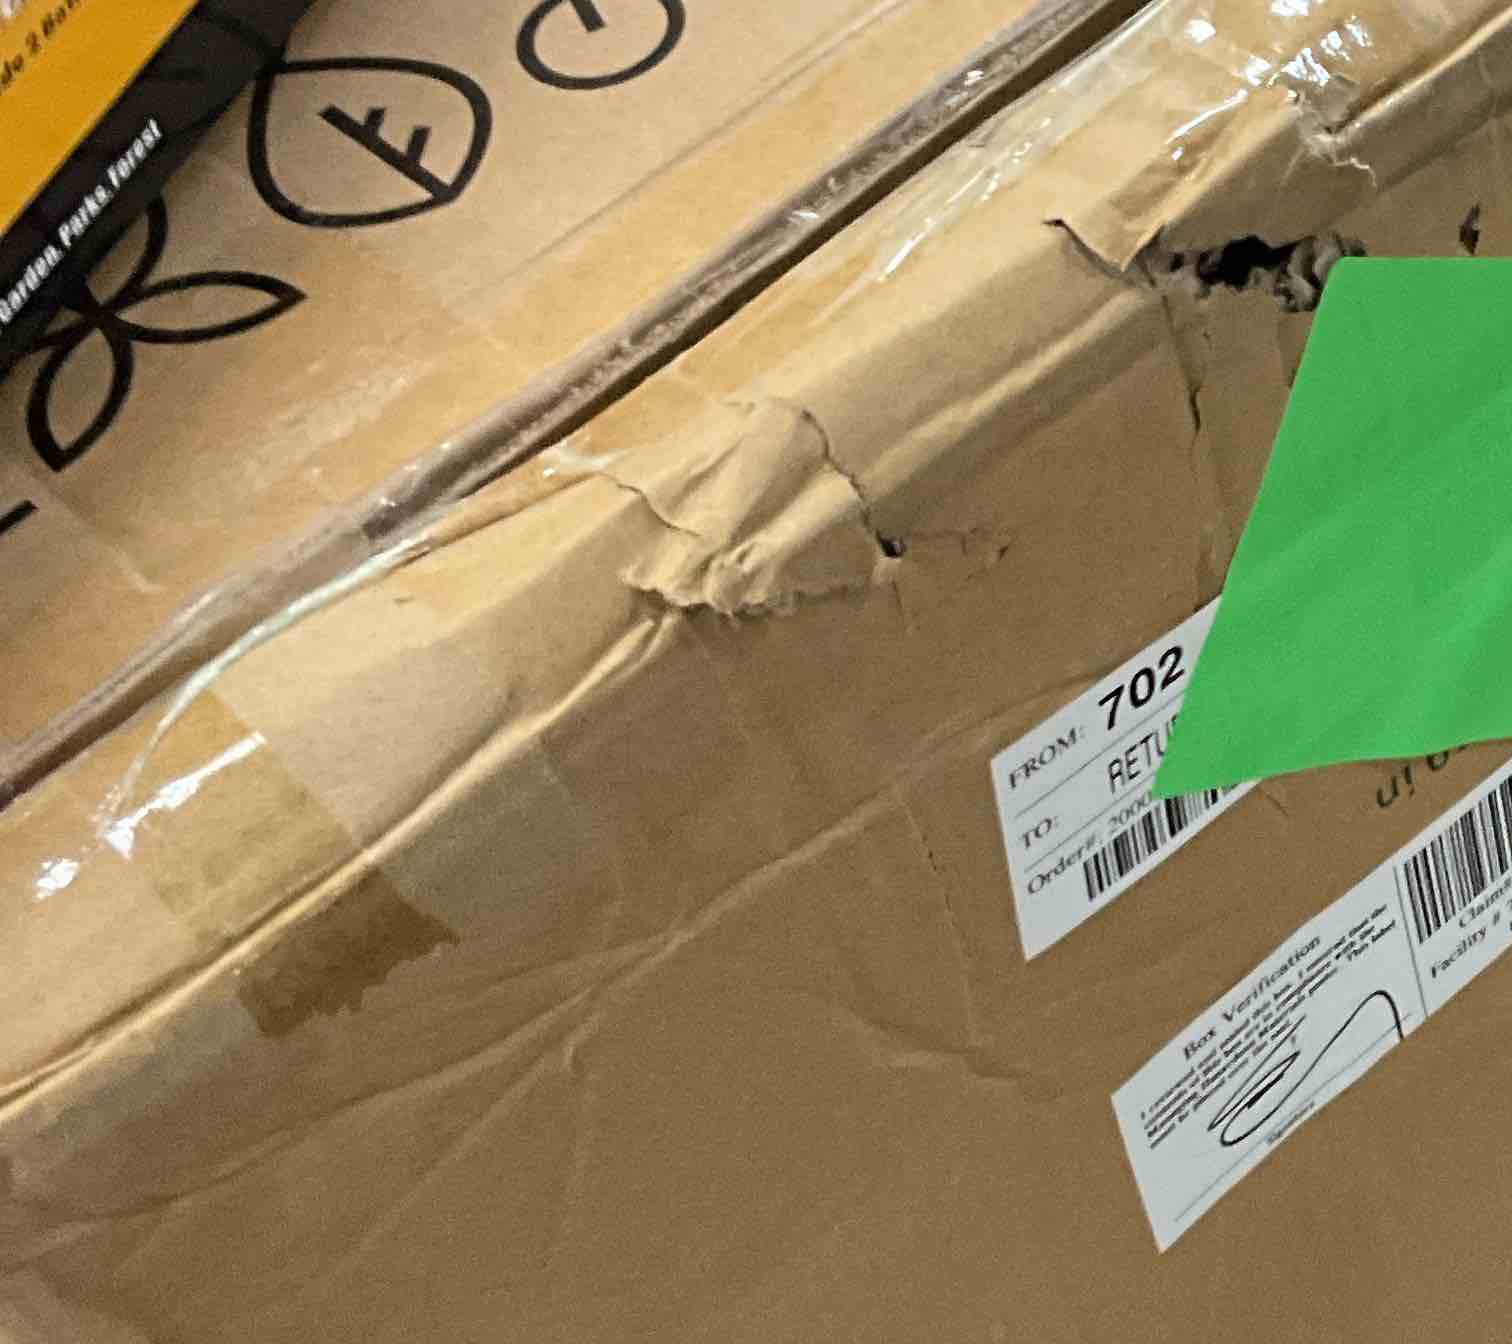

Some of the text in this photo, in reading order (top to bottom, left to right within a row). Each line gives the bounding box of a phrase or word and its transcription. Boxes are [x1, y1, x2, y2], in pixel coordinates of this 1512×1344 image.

[1007, 644, 1186, 790] FROM: 702
[1021, 815, 1059, 851] TO:
[1431, 926, 1487, 978] Facility
[1183, 934, 1321, 1061] Box Verification
